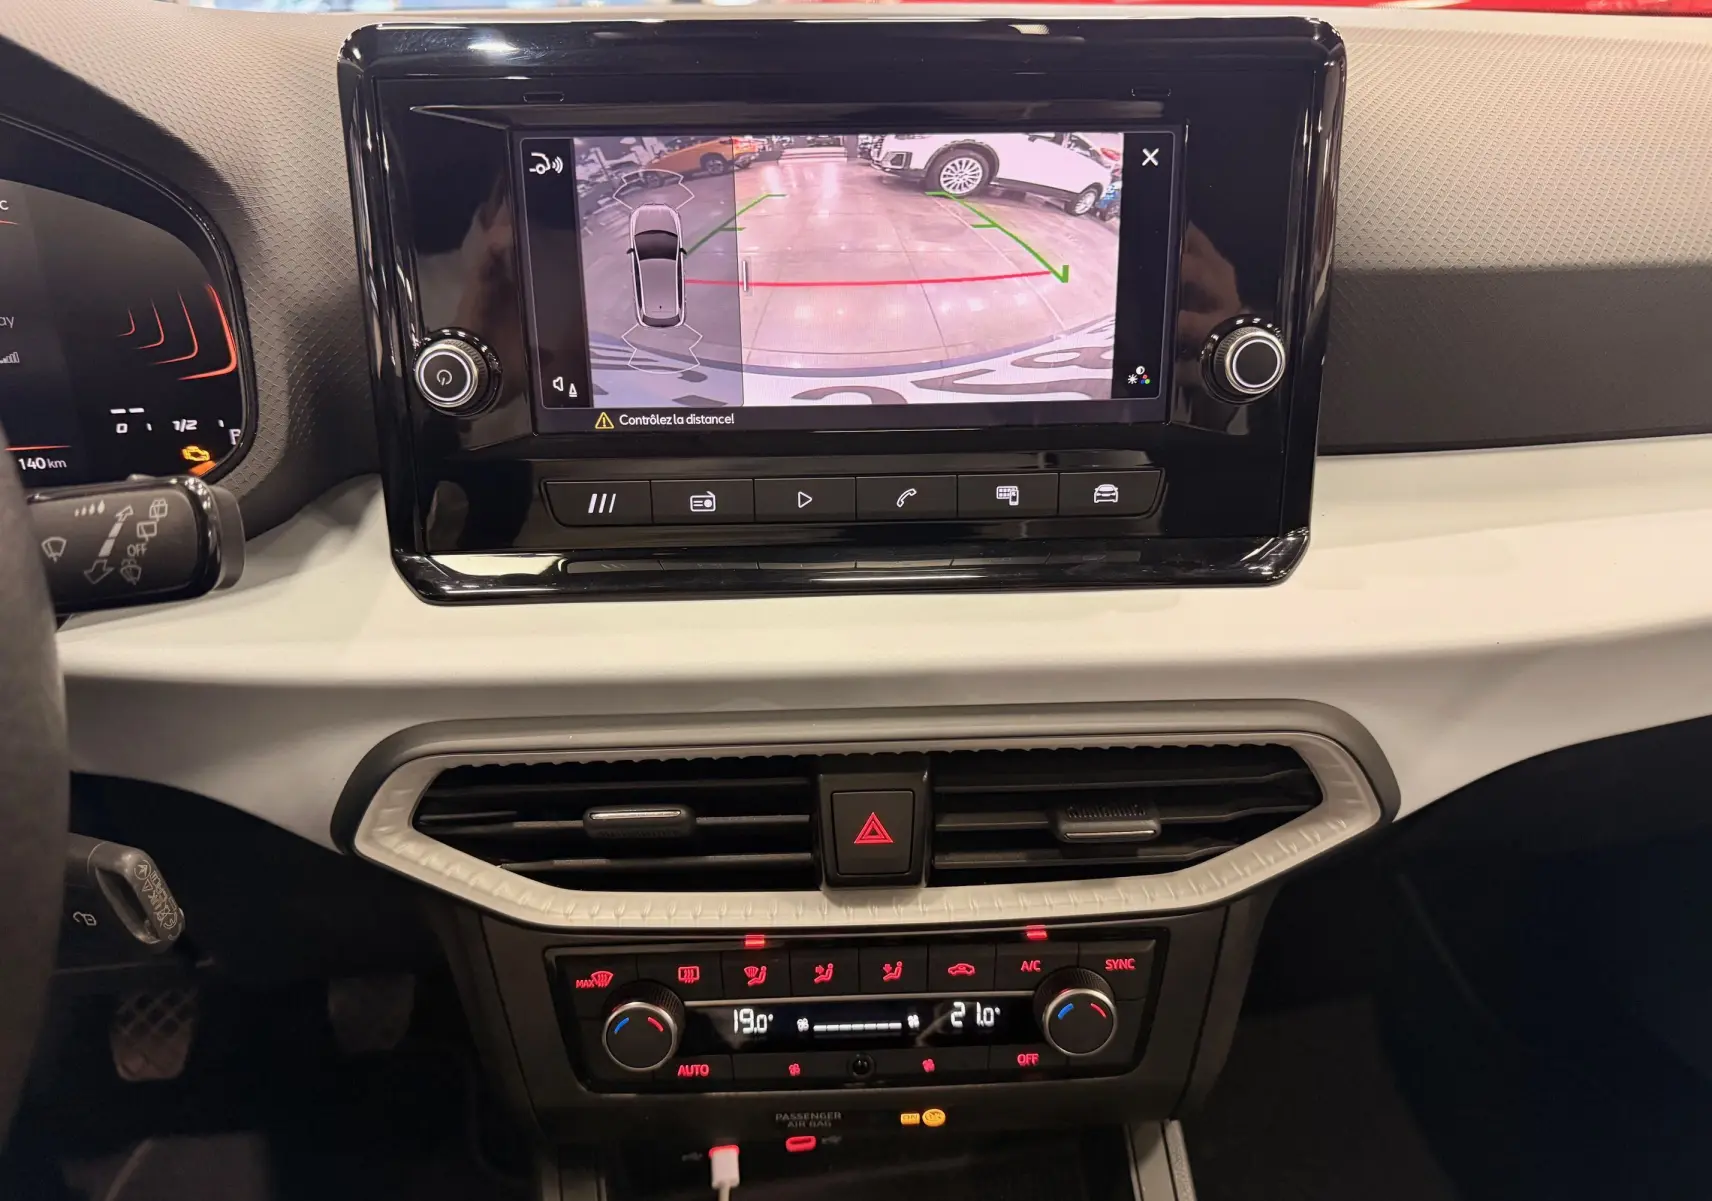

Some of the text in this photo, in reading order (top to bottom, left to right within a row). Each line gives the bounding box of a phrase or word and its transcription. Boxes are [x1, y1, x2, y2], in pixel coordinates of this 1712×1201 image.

[619, 413, 735, 426] Contrôlez la distance!
[172, 419, 198, 433] 1/2
[127, 543, 147, 557] OFF
[1020, 960, 1041, 972] A/C
[1105, 958, 1136, 970] SYNC
[575, 979, 594, 989] MAX
[1017, 1053, 1039, 1067] OFF
[677, 1064, 710, 1077] AUTO
[775, 1111, 842, 1122] PASSENGER
[787, 1120, 807, 1129] AIR
